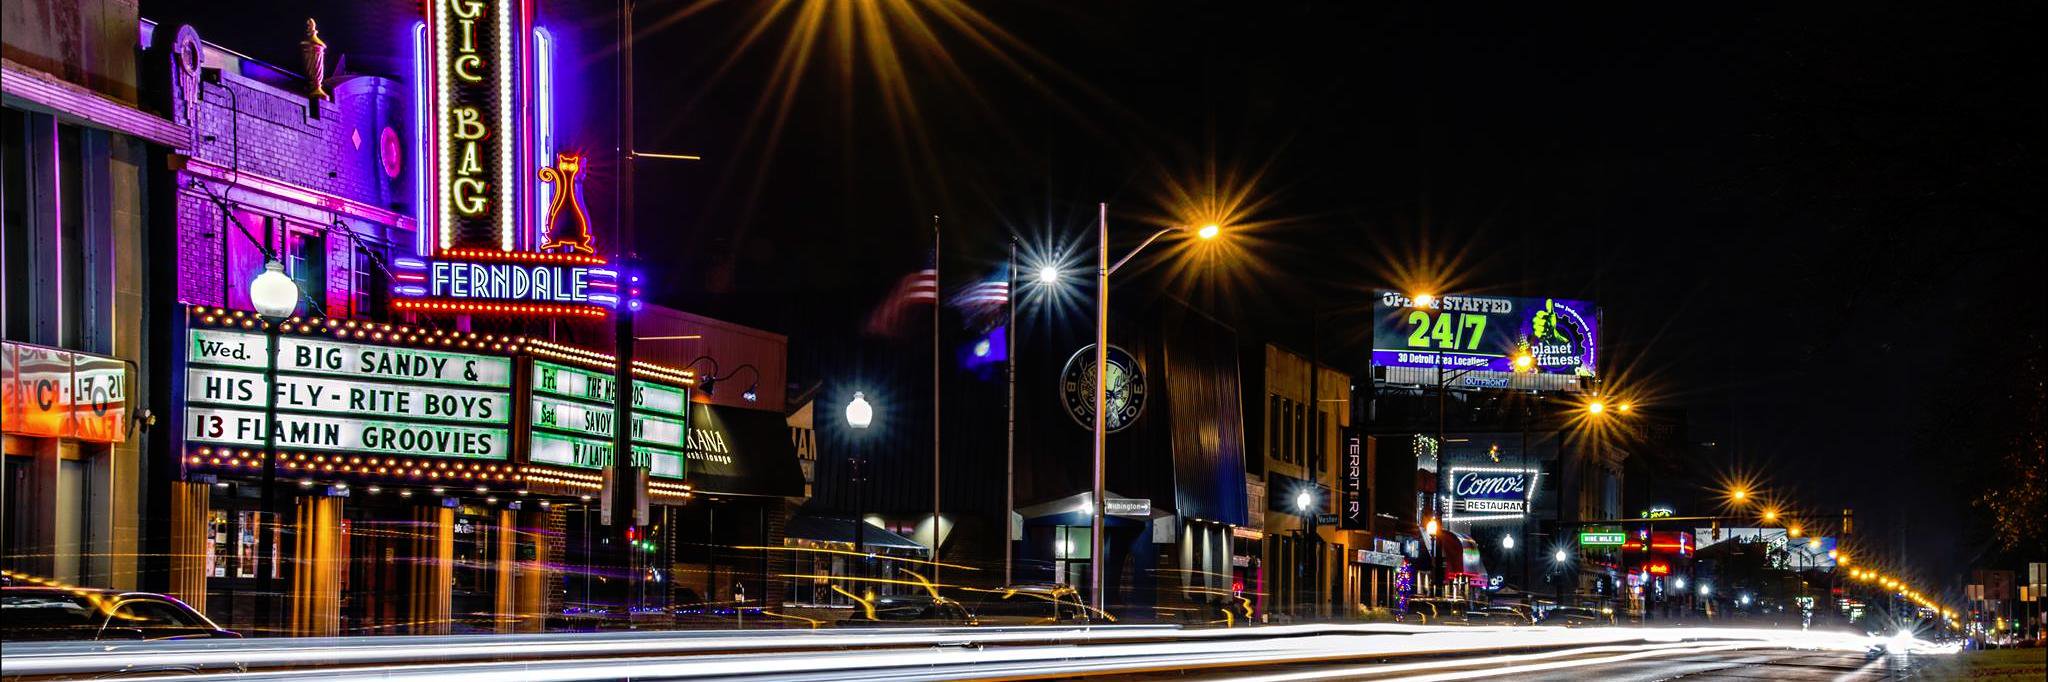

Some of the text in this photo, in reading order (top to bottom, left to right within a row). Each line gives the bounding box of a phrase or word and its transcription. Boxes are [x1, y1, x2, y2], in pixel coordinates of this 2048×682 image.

[453, 107, 486, 214] BAG
[432, 262, 588, 301] FERNDALE
[1443, 296, 1512, 313] STAFFED
[1408, 310, 1487, 350] 24/7
[198, 339, 479, 382] Wed. BIG SANDY &
[1398, 352, 1489, 367] 30 Detroit Area Locations
[1531, 342, 1572, 357] planet
[1537, 354, 1581, 366] fitness
[206, 376, 253, 401] HIS
[425, 393, 493, 419] BOYS
[587, 376, 602, 398] THE
[196, 414, 492, 455] 13 FLAMIN GROOVIES
[585, 410, 612, 437] SAVOY
[687, 427, 728, 454] KANA
[705, 451, 732, 465] lounge
[1456, 471, 1524, 496] Como's
[1467, 501, 1524, 511] RESTAURAN
